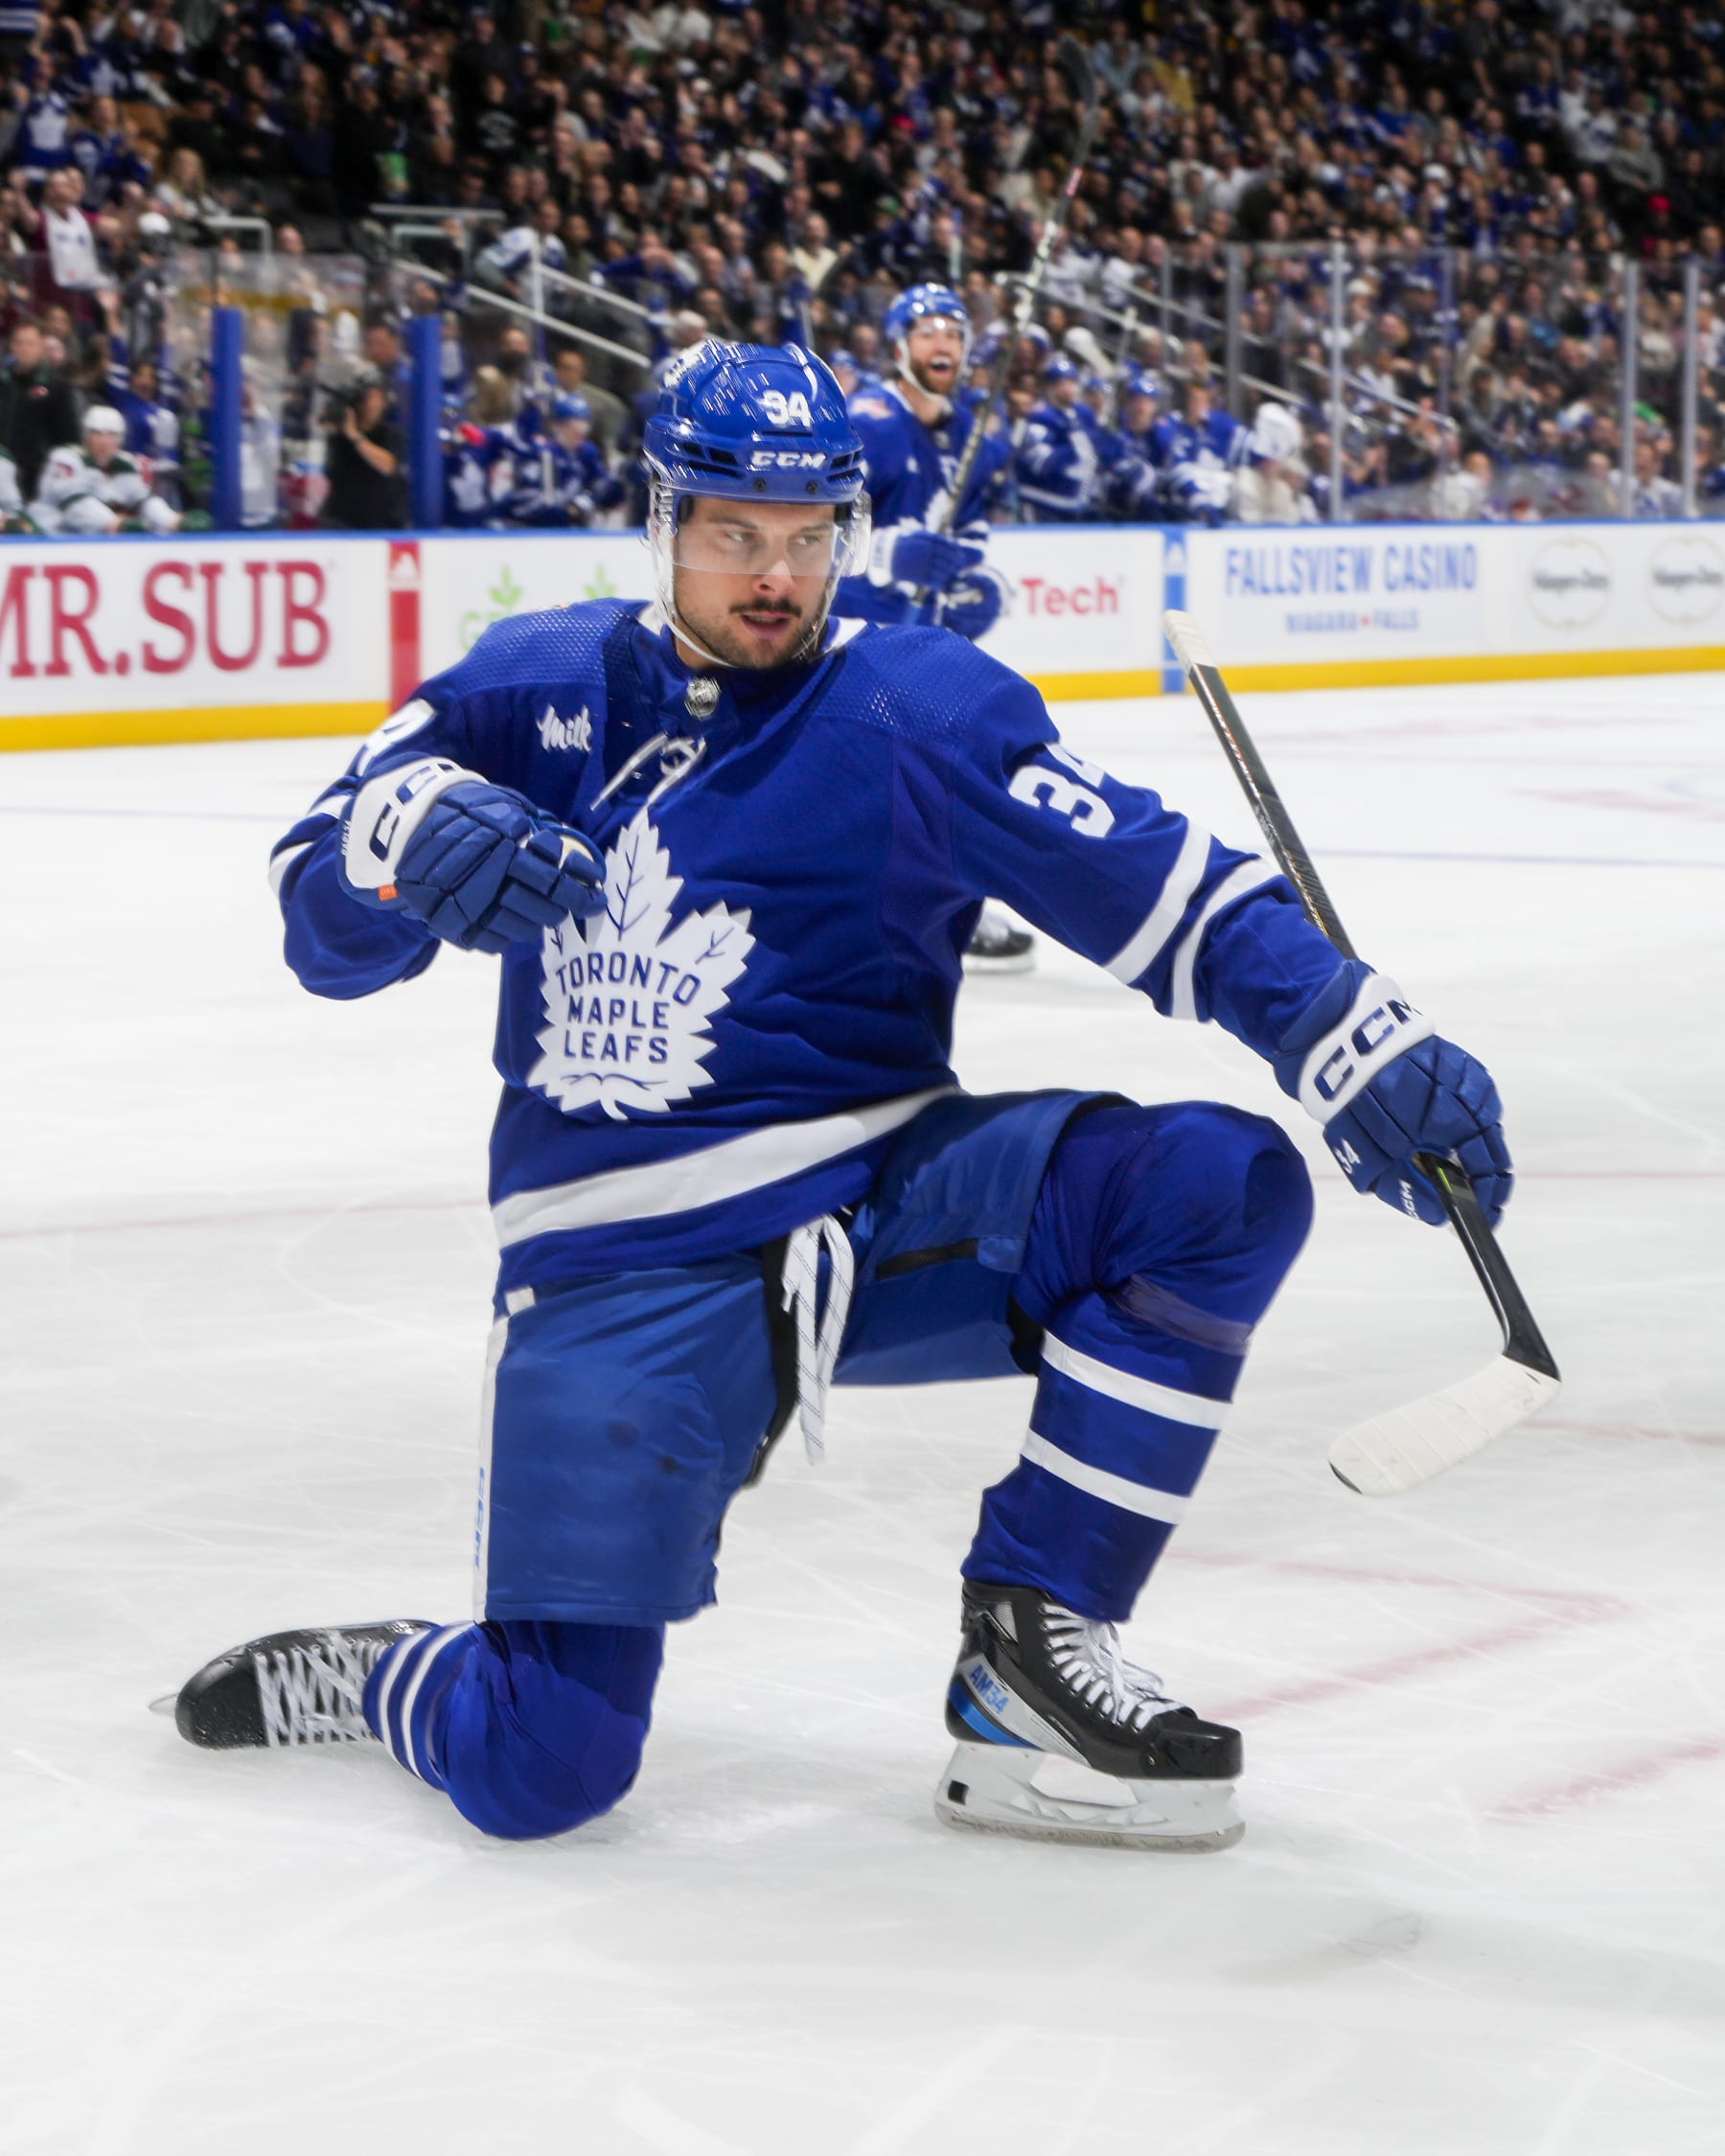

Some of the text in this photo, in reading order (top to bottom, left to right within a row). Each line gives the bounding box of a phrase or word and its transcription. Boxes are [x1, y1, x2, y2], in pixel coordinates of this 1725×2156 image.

[750, 449, 827, 468] CCM
[1225, 546, 1374, 597] FALLSVIEW
[1383, 543, 1478, 592] CASINO
[1021, 577, 1119, 616] Tech
[537, 705, 592, 751] Milk
[556, 952, 702, 1006] TORONTO
[565, 995, 672, 1031] MAPLE
[563, 1030, 671, 1066] LEAFS
[971, 1664, 1009, 1713] AM34
